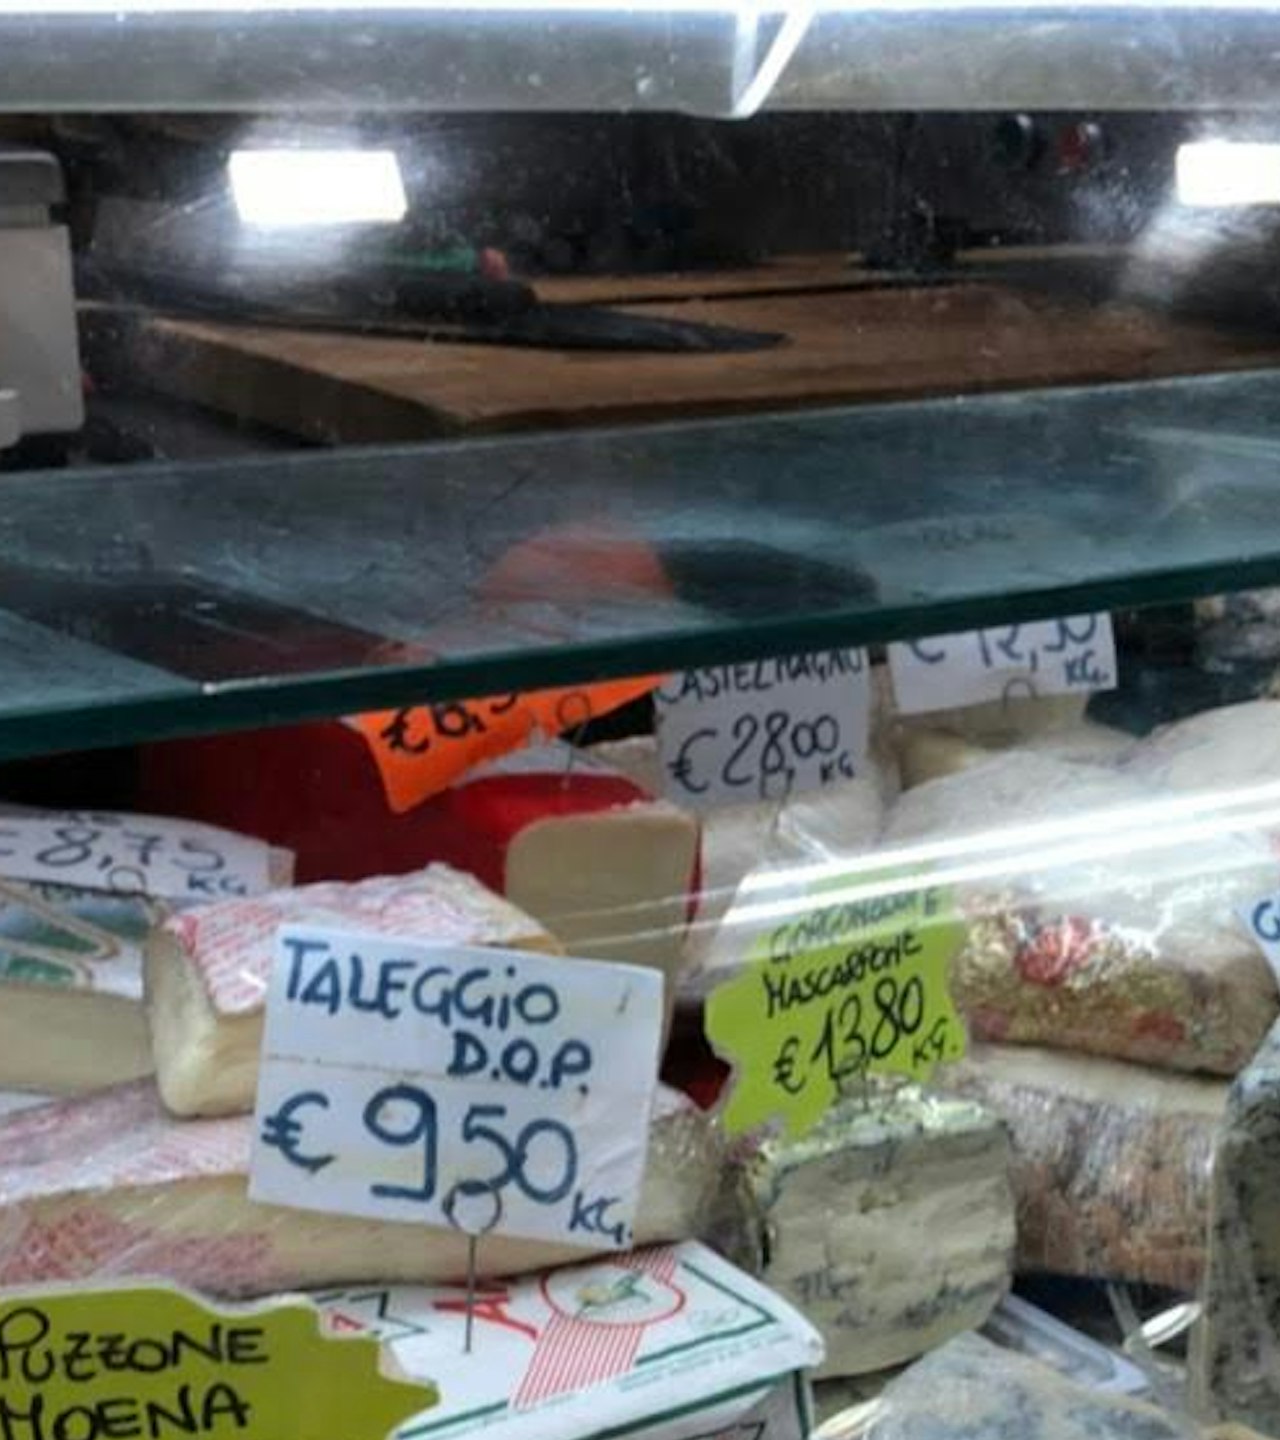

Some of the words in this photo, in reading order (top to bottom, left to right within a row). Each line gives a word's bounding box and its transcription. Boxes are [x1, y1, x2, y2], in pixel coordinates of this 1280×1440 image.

[283, 937, 560, 1031] TALEGGIO
[446, 1030, 593, 1096] D.O.P.
[261, 1091, 337, 1173] €
